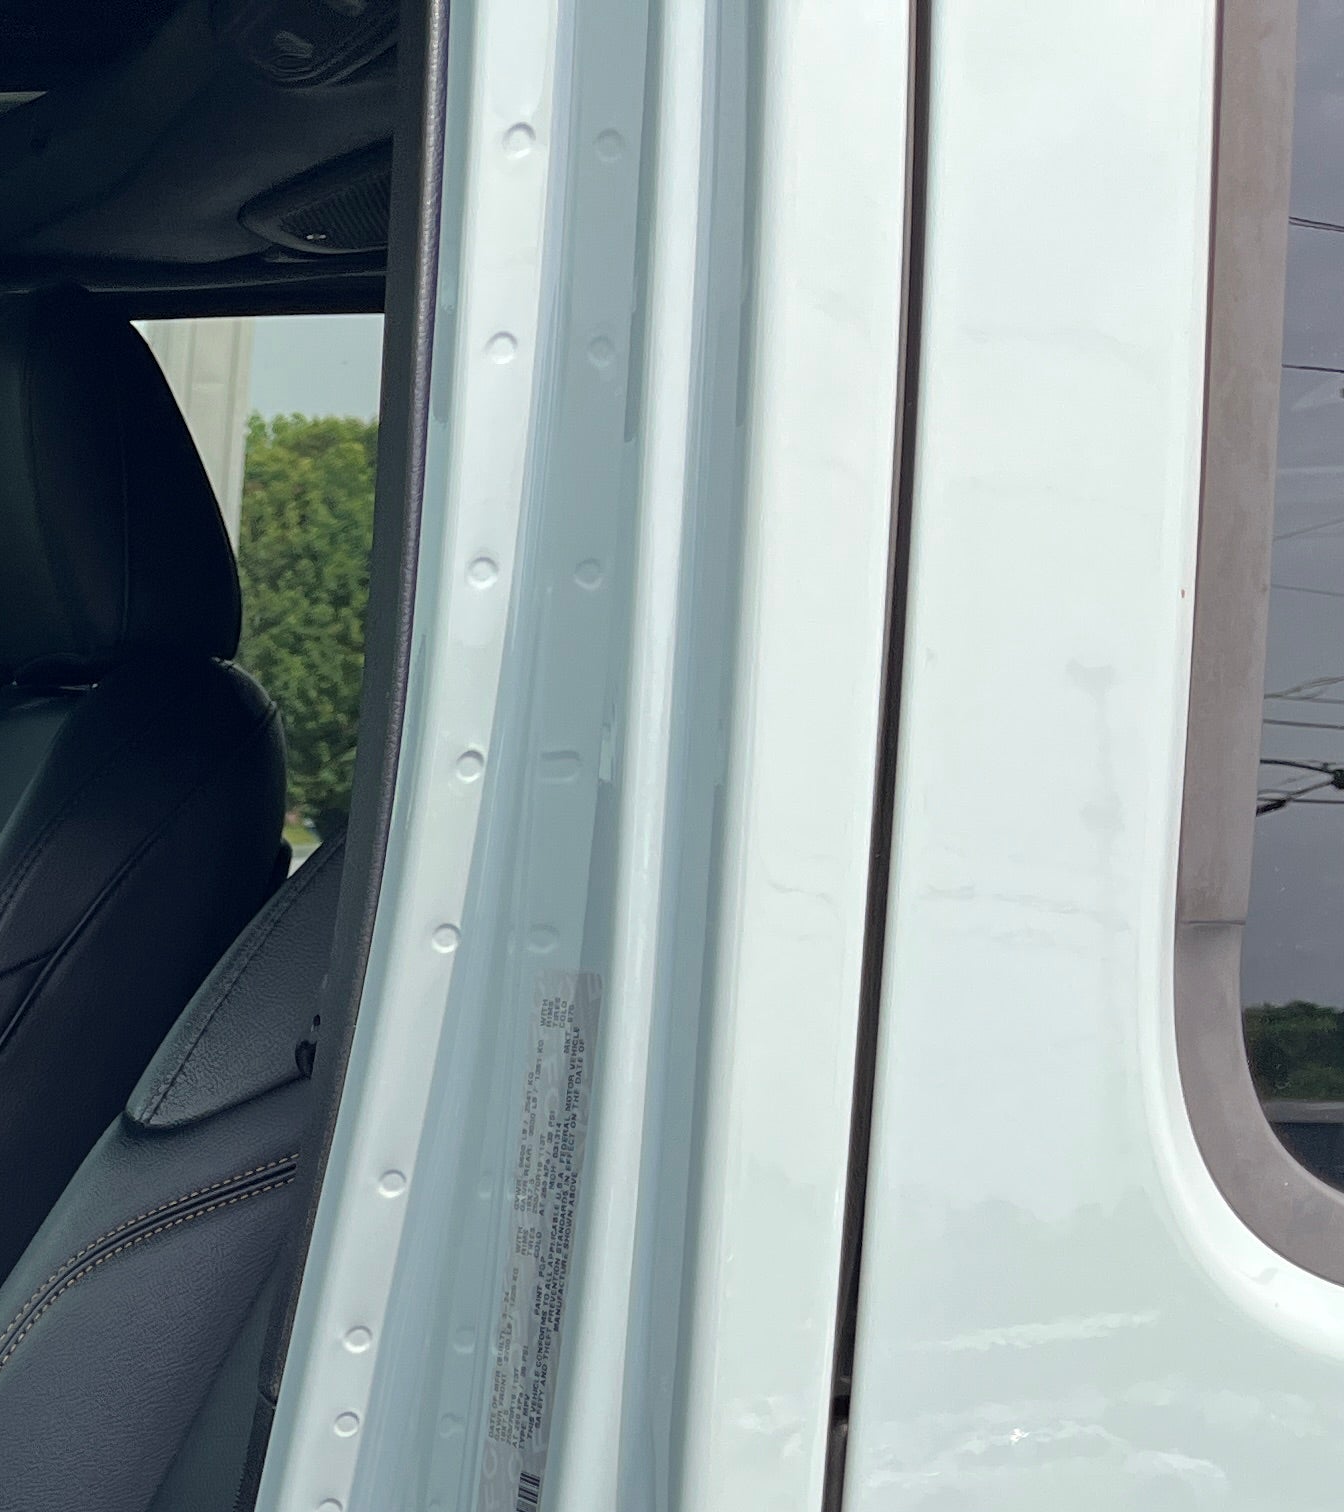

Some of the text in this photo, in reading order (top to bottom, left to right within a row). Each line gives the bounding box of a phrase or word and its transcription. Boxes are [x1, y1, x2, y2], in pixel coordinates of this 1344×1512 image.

[539, 999, 548, 1025] WITH
[545, 999, 554, 1027] RIMS
[550, 996, 561, 1027] TIRES
[568, 1025, 580, 1069] VEHICLE
[577, 1038, 585, 1052] OF
[574, 1056, 584, 1084] DATE
[537, 1202, 545, 1215] AT
[557, 1000, 568, 1028] COLD
[564, 1074, 575, 1110] MOTOR
[571, 1088, 580, 1109] THE
[570, 1113, 577, 1128] ON
[558, 1115, 570, 1162] FEDERAL
[564, 1133, 576, 1171] EFFECT
[546, 1204, 560, 1267] APPLICABLE
[555, 1190, 569, 1253] STANDARDS
[514, 1226, 523, 1252] WITH
[520, 1229, 528, 1255] RIMS
[526, 1227, 535, 1255] TIRES
[544, 1270, 552, 1289] ALL
[552, 1253, 568, 1331] MANUFACTURE
[562, 1209, 573, 1249] SHOWN
[542, 1293, 549, 1305] TO
[547, 1257, 561, 1323] PREVENTION
[511, 1434, 518, 1448] AT
[532, 1231, 542, 1258] COLD
[535, 1310, 547, 1367] CONFORMS
[542, 1327, 552, 1360] THEFT
[539, 1363, 548, 1386] AND
[522, 1393, 530, 1416] MPV
[529, 1370, 540, 1412] VEHICLE
[534, 1389, 544, 1428] SAFETY
[526, 1415, 534, 1439] THIS
